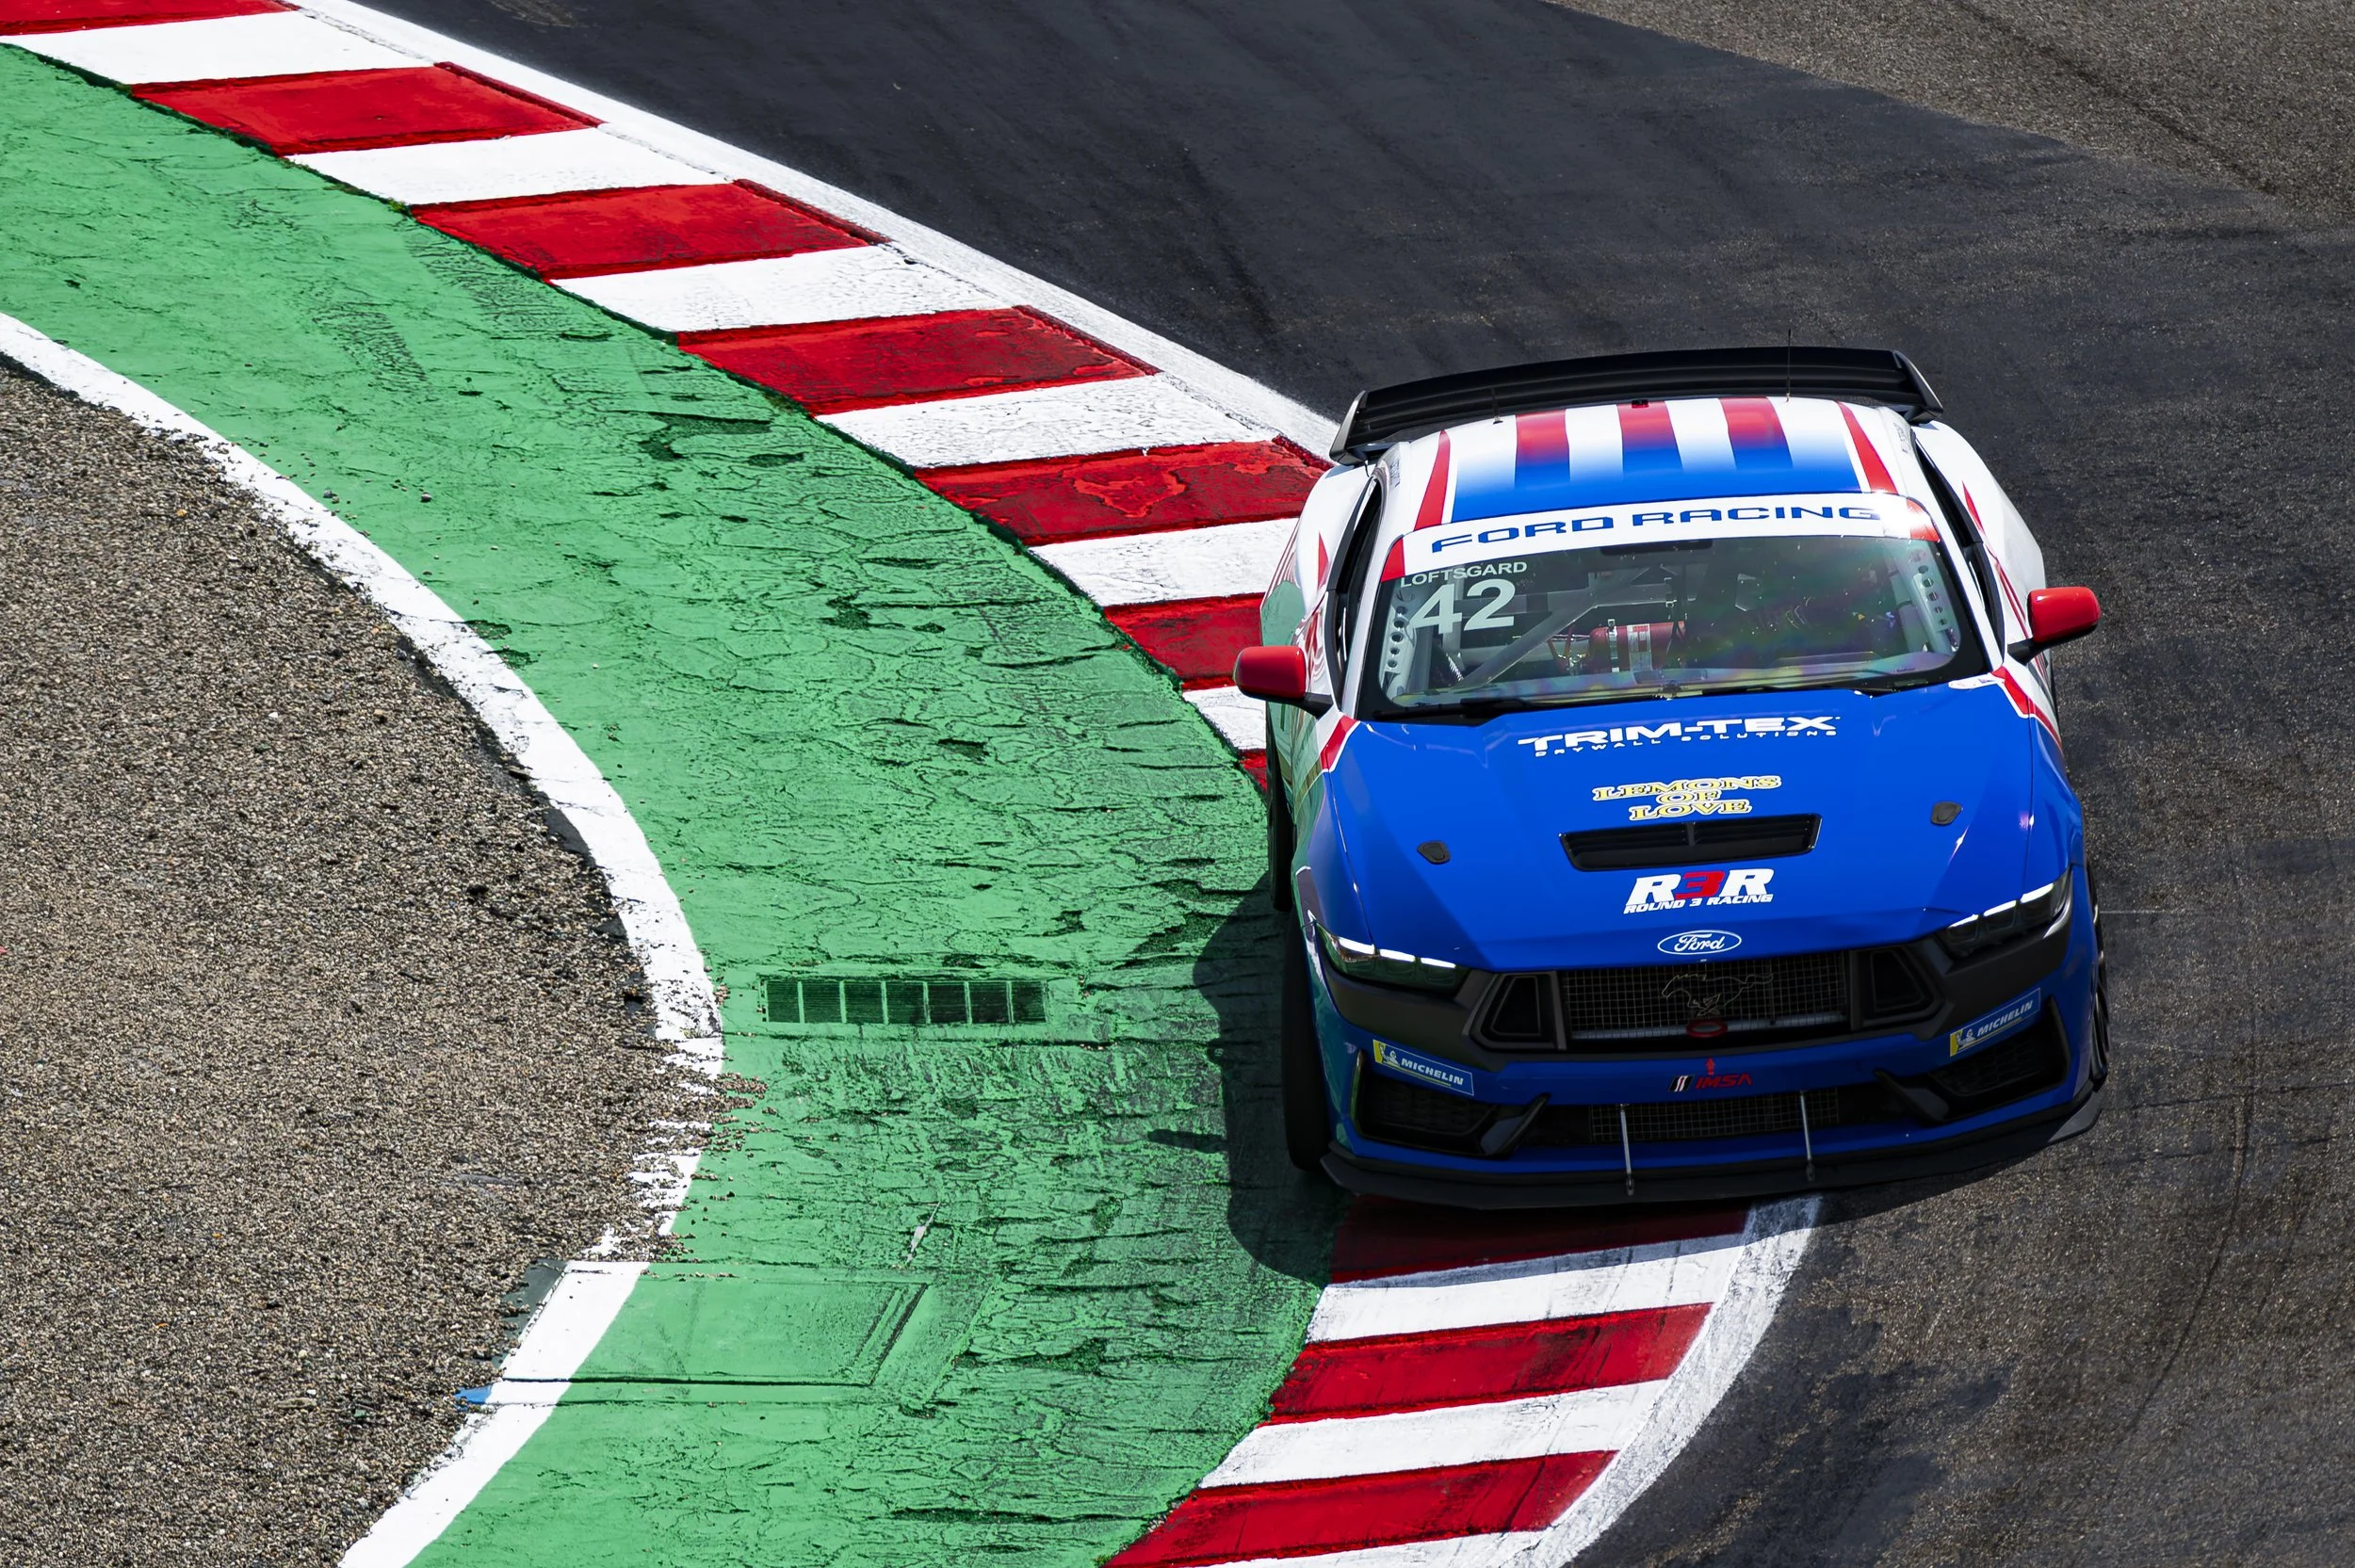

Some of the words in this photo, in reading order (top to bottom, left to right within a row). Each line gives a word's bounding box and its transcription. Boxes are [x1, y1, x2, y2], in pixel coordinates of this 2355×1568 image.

[1432, 517, 1614, 553] FORD
[1632, 507, 1880, 525] RACING
[1400, 561, 1527, 588] LOFTSGARD
[1413, 578, 1516, 635] 42
[1518, 717, 1836, 752] TRIM-TEX
[1593, 776, 1780, 800] LEMONS
[1657, 789, 1721, 804] OF
[1630, 800, 1752, 820] LOVE
[1626, 868, 1774, 905] R3R
[1623, 899, 1686, 914] ROUND
[1689, 897, 1702, 907] 3
[1707, 894, 1774, 906] RACING
[1674, 933, 1725, 952] Ford
[1977, 1000, 2034, 1037] MICHELIN
[1401, 1058, 1464, 1085] MICHELIN
[1696, 1073, 1752, 1090] IMSA
